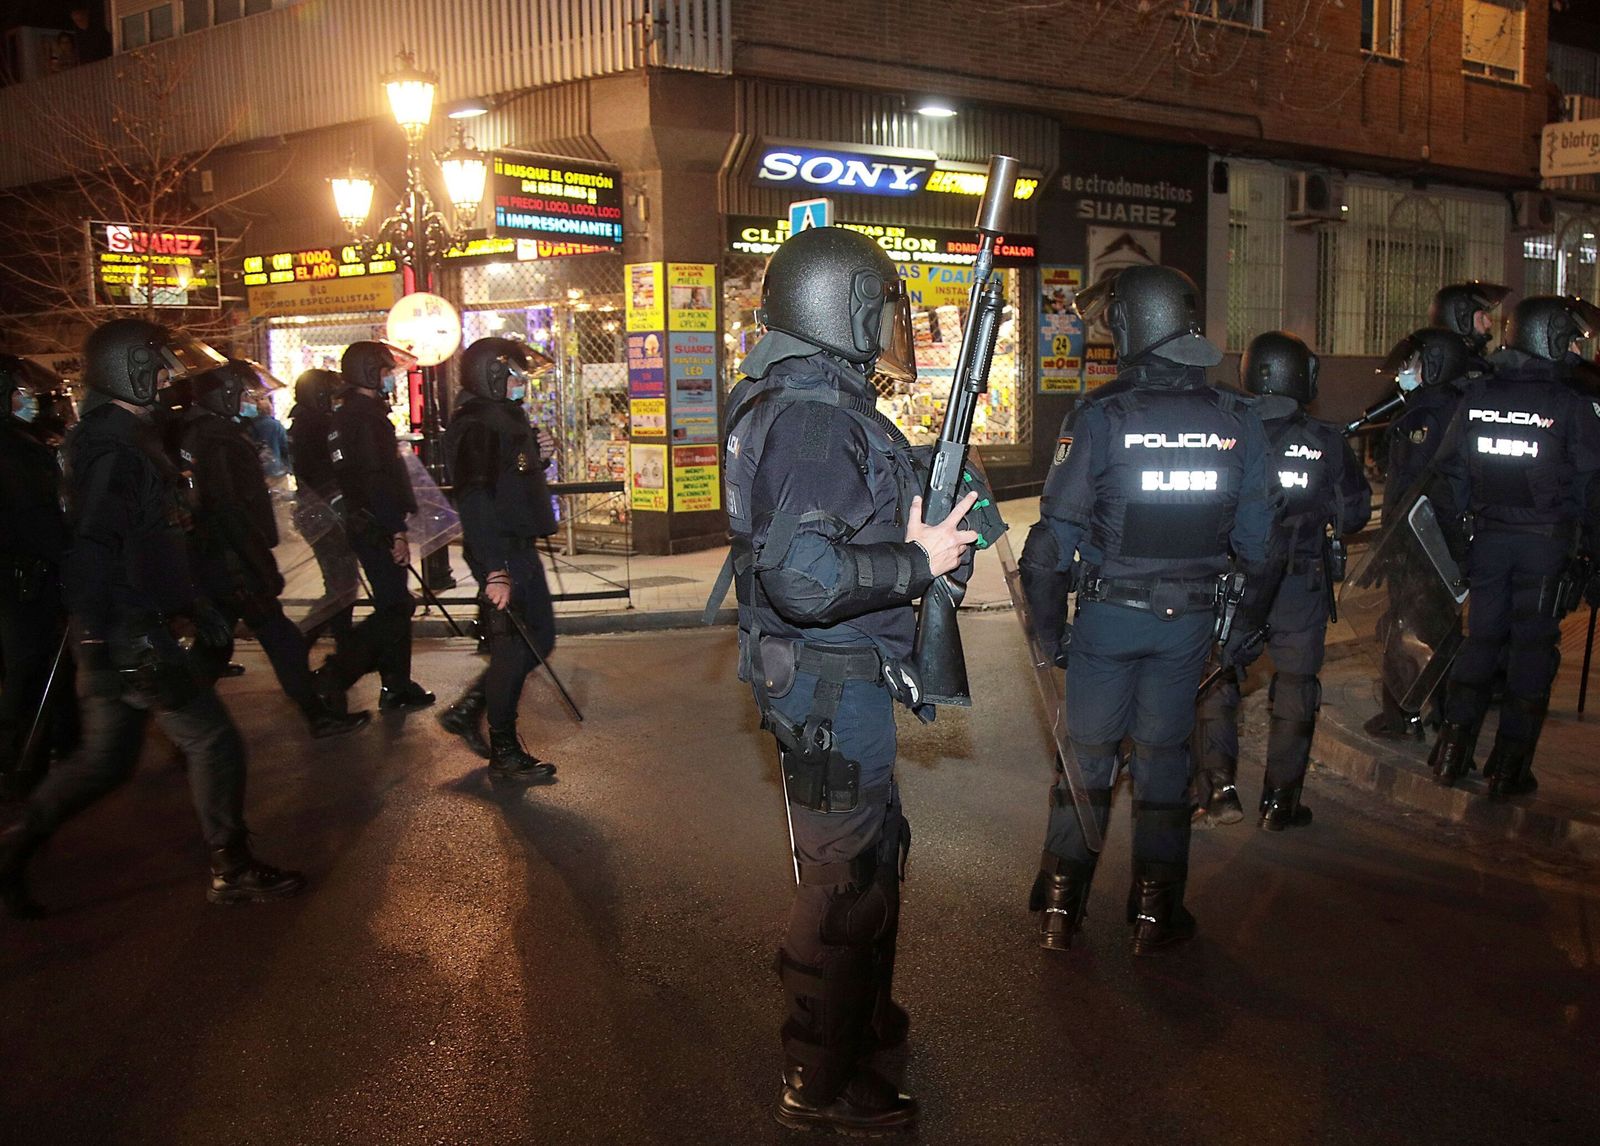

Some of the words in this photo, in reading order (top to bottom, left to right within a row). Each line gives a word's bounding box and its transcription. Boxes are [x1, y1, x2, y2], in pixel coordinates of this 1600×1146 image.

[504, 163, 549, 181] BUSQUE
[551, 170, 563, 183] EL
[521, 179, 537, 193] DE
[538, 182, 563, 196] ESTE
[564, 185, 587, 199] MES
[511, 196, 543, 210] PRECIO
[1077, 199, 1176, 226] SUAREZ
[506, 213, 613, 237] IMPRESIONANTE
[110, 229, 203, 256] SUAREZ
[1002, 245, 1035, 257] CALOR
[300, 250, 331, 264] TODO
[295, 266, 310, 279] EL
[312, 261, 338, 279] AÑO
[1055, 338, 1067, 350] 24
[1086, 347, 1111, 360] AIRE
[684, 367, 703, 375] LED
[1468, 409, 1541, 427] POLICIA
[1124, 433, 1222, 449] POLICIA
